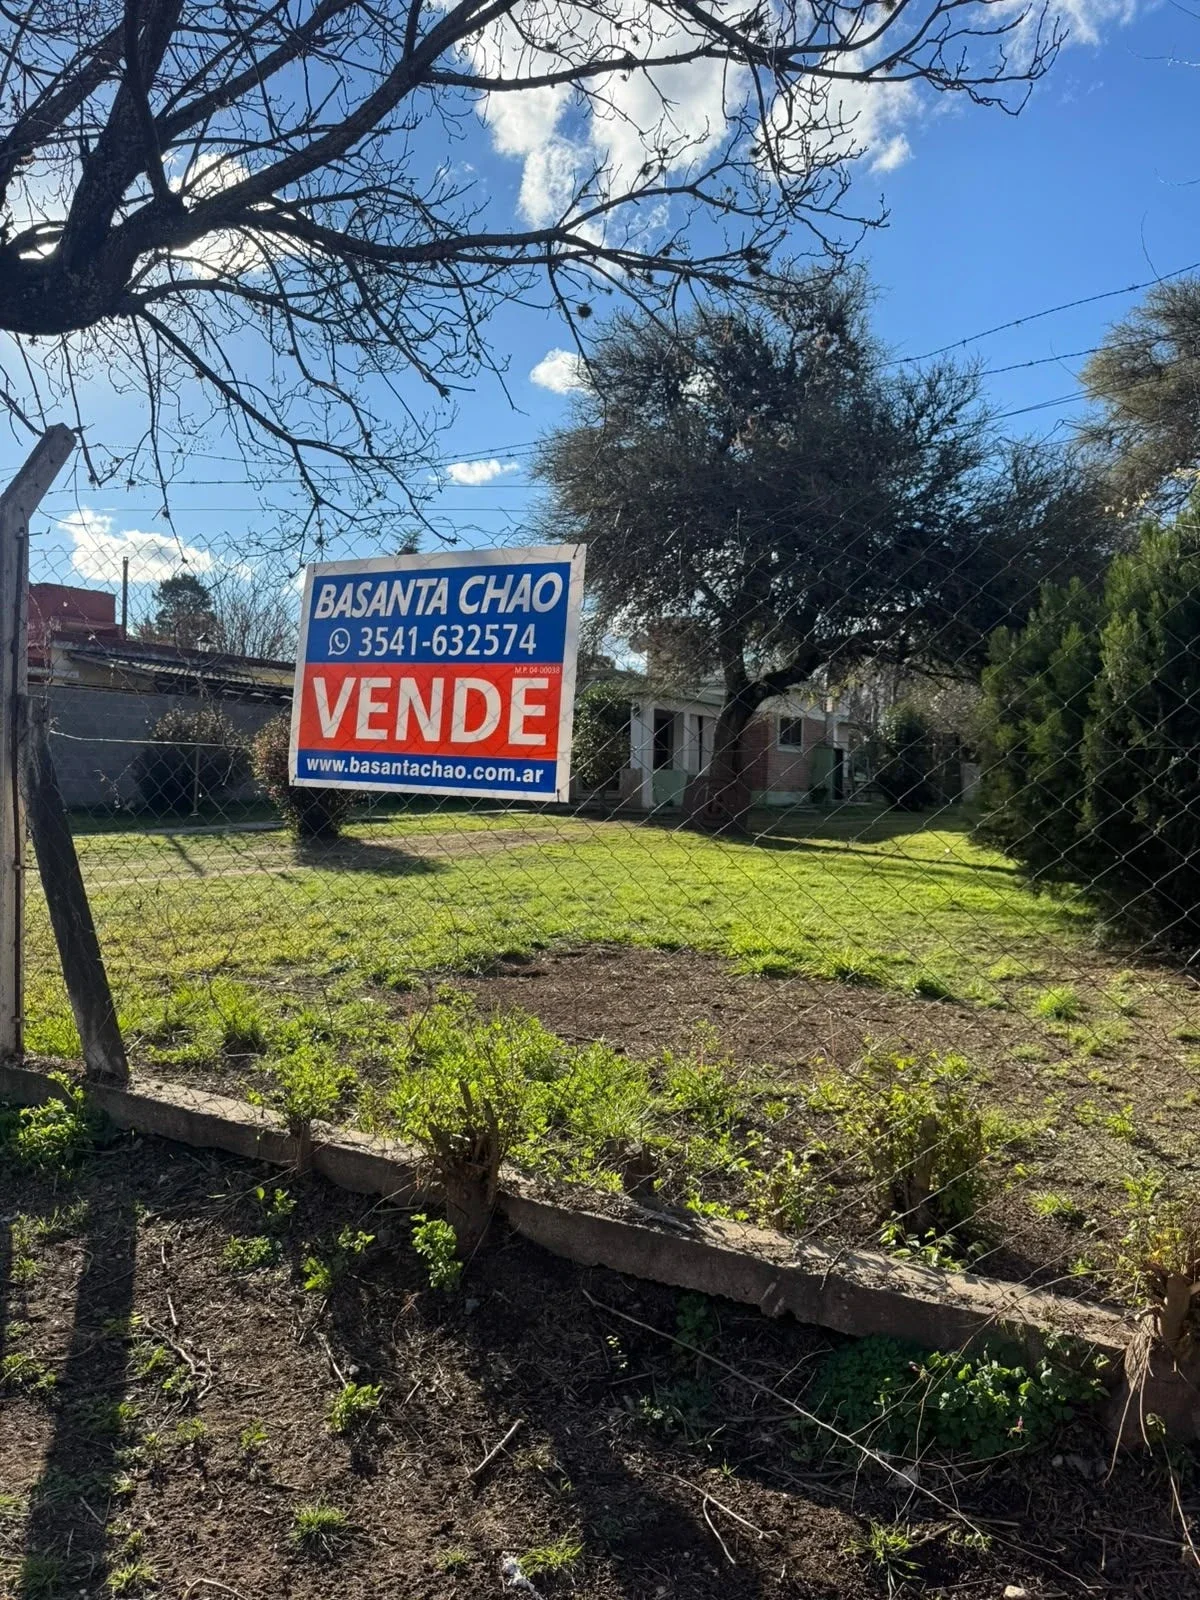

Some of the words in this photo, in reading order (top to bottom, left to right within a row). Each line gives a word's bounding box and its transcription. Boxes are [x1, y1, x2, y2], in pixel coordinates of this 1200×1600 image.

[314, 577, 449, 619] BASANTA
[459, 571, 563, 614] CHAO
[358, 623, 537, 656] 3541-632574
[313, 677, 549, 746] VENDE
[306, 756, 544, 783] www.basantachao.com.ar
